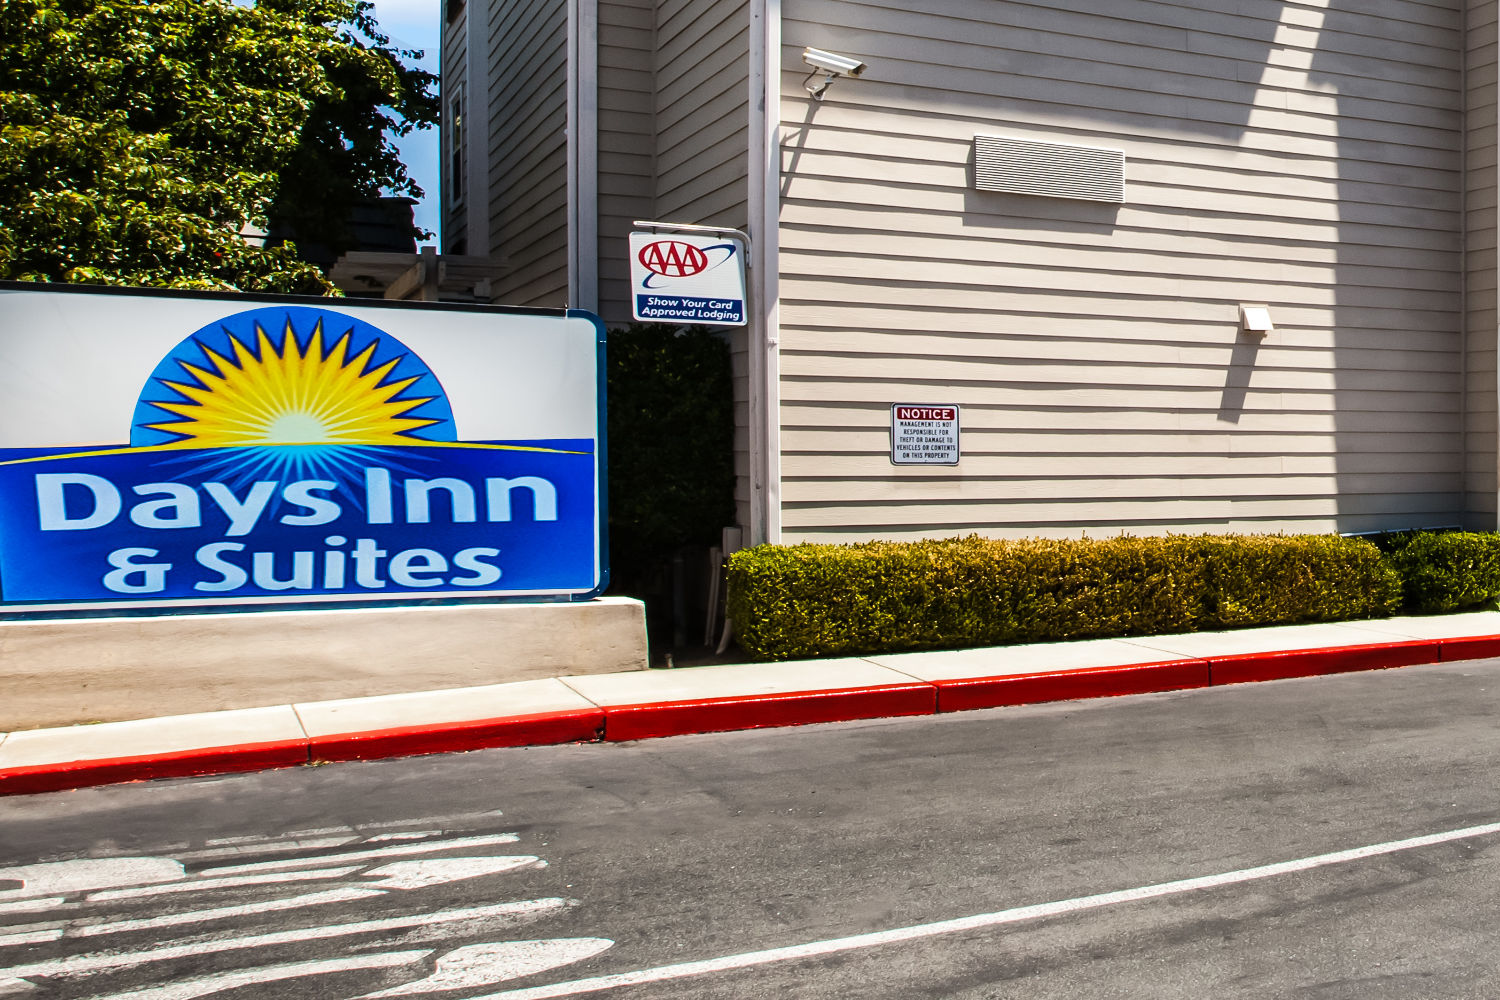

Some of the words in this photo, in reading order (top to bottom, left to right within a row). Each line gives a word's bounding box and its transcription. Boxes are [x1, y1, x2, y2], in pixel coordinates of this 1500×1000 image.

[647, 241, 701, 277] AAA
[642, 307, 695, 317] Approved
[698, 310, 740, 321] Lodging
[647, 297, 679, 306] Show
[682, 299, 706, 308] Your
[708, 301, 733, 309] Card
[901, 409, 951, 419] NOTICE
[35, 472, 342, 536] Days
[365, 467, 558, 524] Inn
[102, 548, 171, 593] &
[194, 535, 502, 592] Suites
